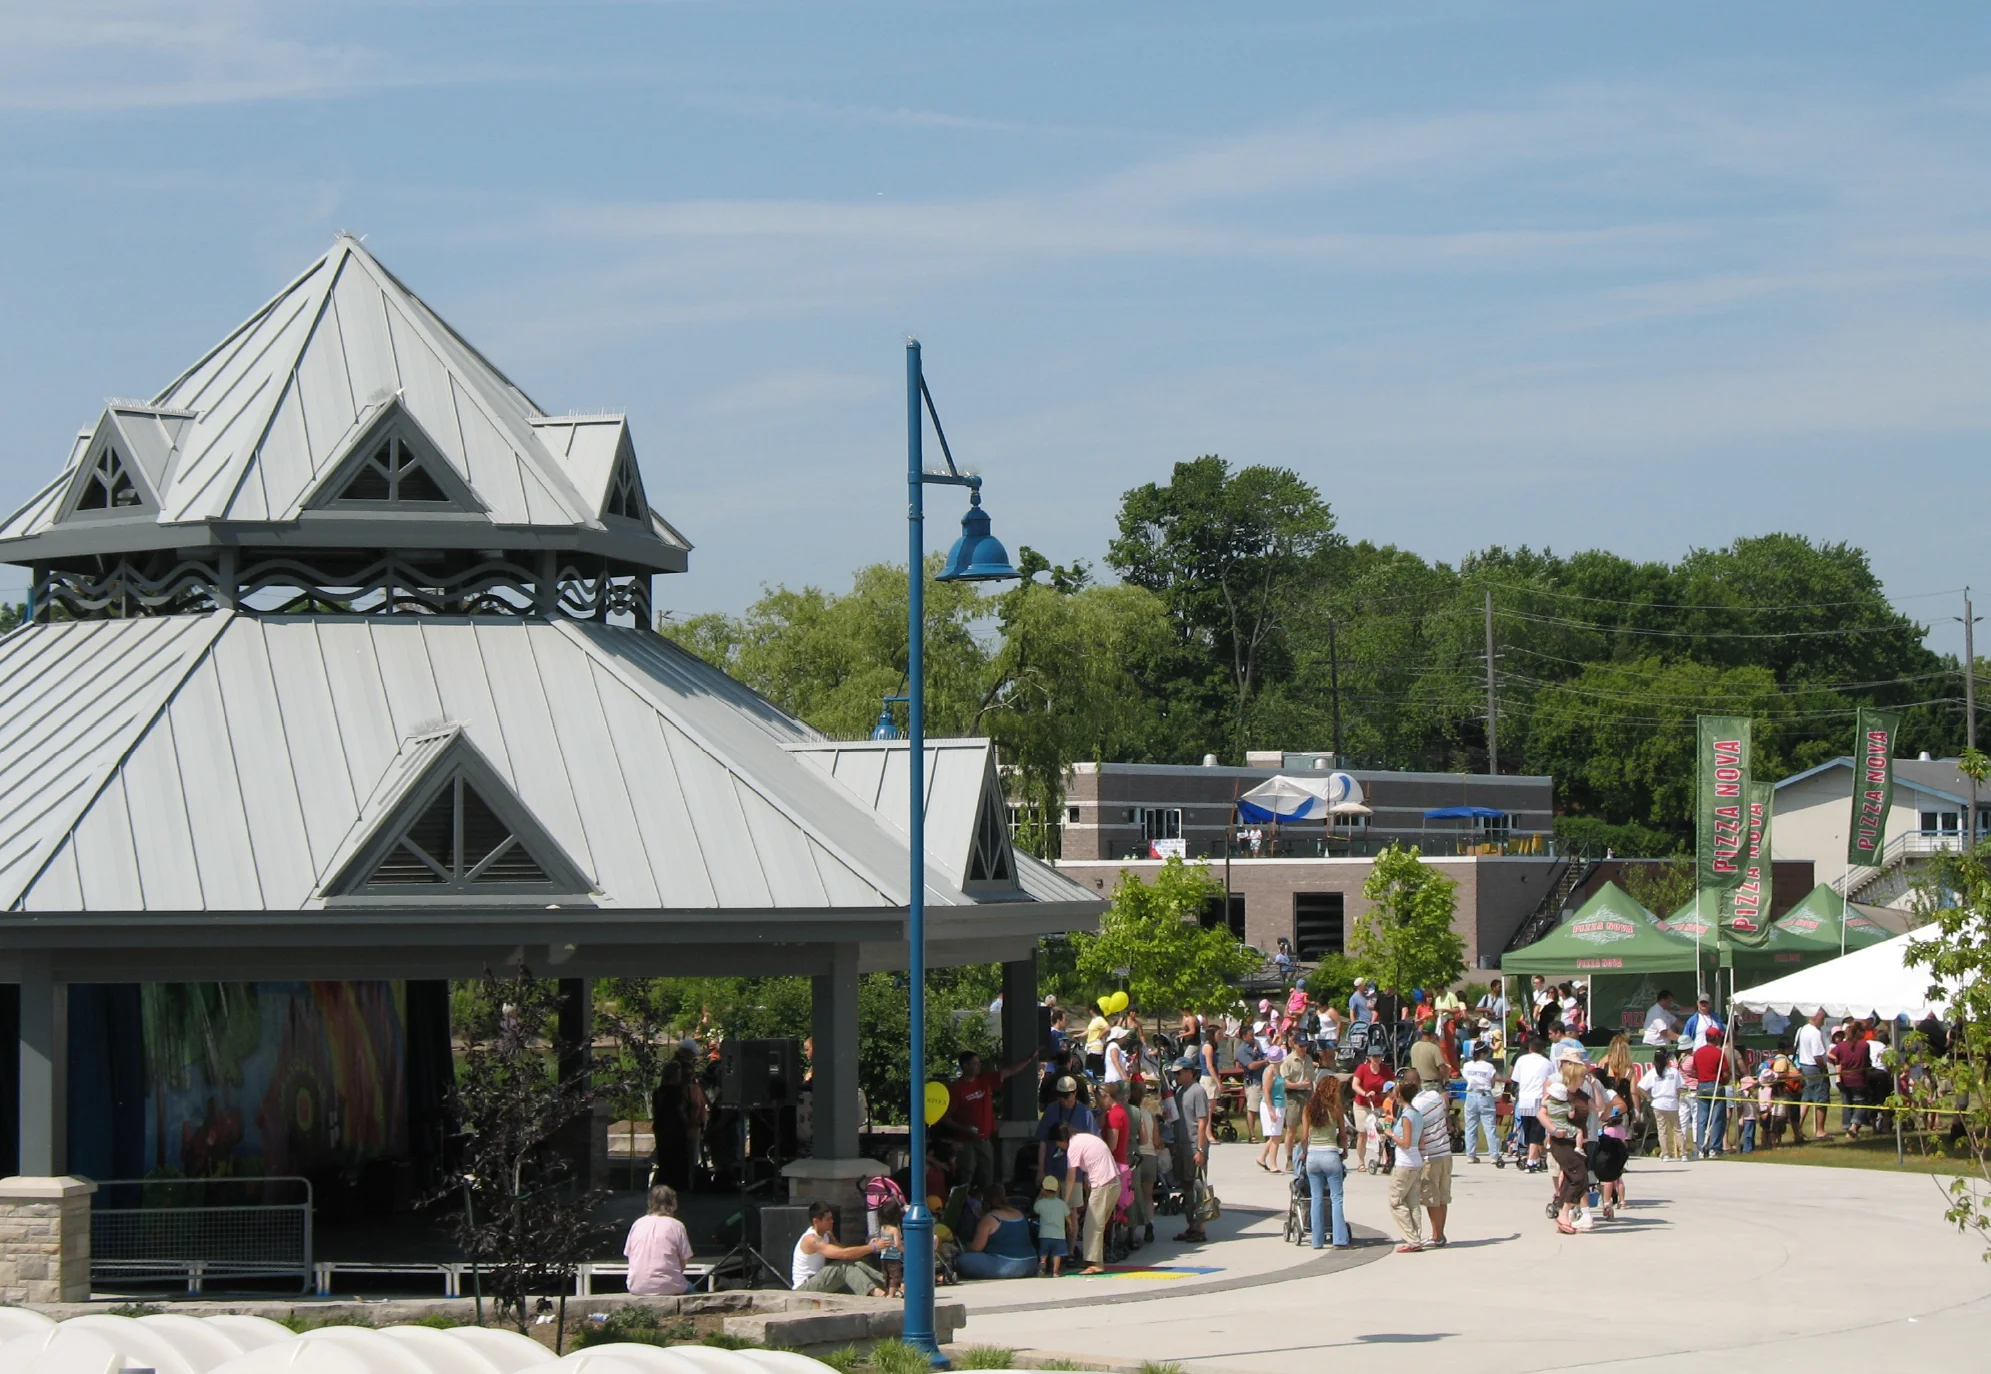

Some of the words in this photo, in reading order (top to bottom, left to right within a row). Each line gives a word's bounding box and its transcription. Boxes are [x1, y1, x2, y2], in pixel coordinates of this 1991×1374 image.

[1714, 740, 1741, 797] NOVA
[1866, 730, 1888, 784] NOVA
[1713, 805, 1740, 873] PIZZA
[1857, 790, 1883, 850] PIZZA
[1732, 866, 1760, 931] PIZZA
[1573, 921, 1604, 934] PIZZA
[1606, 921, 1634, 934] NOVA
[1621, 1011, 1645, 1028] PIZZ
